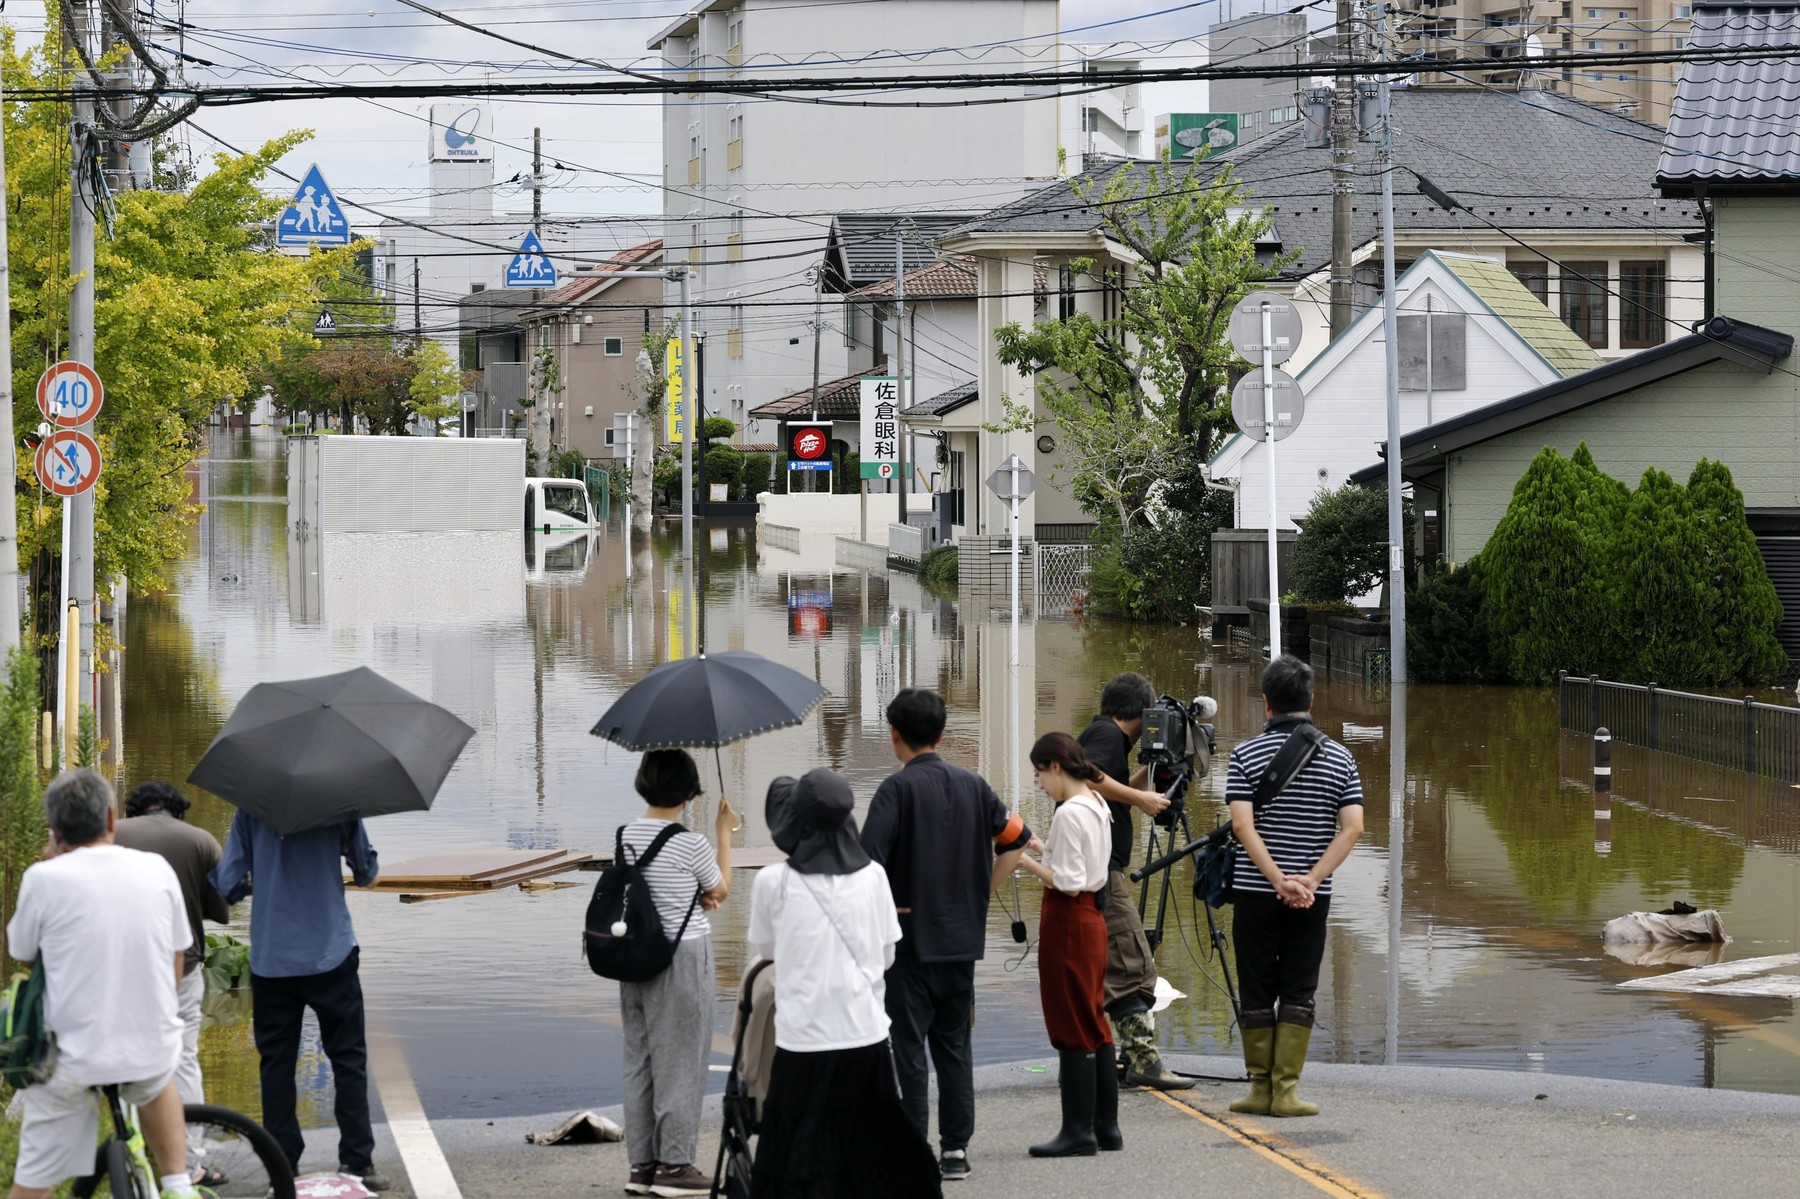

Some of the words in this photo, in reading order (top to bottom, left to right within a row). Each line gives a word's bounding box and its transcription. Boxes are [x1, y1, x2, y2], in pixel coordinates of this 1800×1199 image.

[56, 381, 87, 408] 40
[874, 382, 896, 459] 佐倉眼科
[799, 440, 820, 451] Pizza
[803, 445, 818, 453] Hut
[882, 465, 891, 477] P
